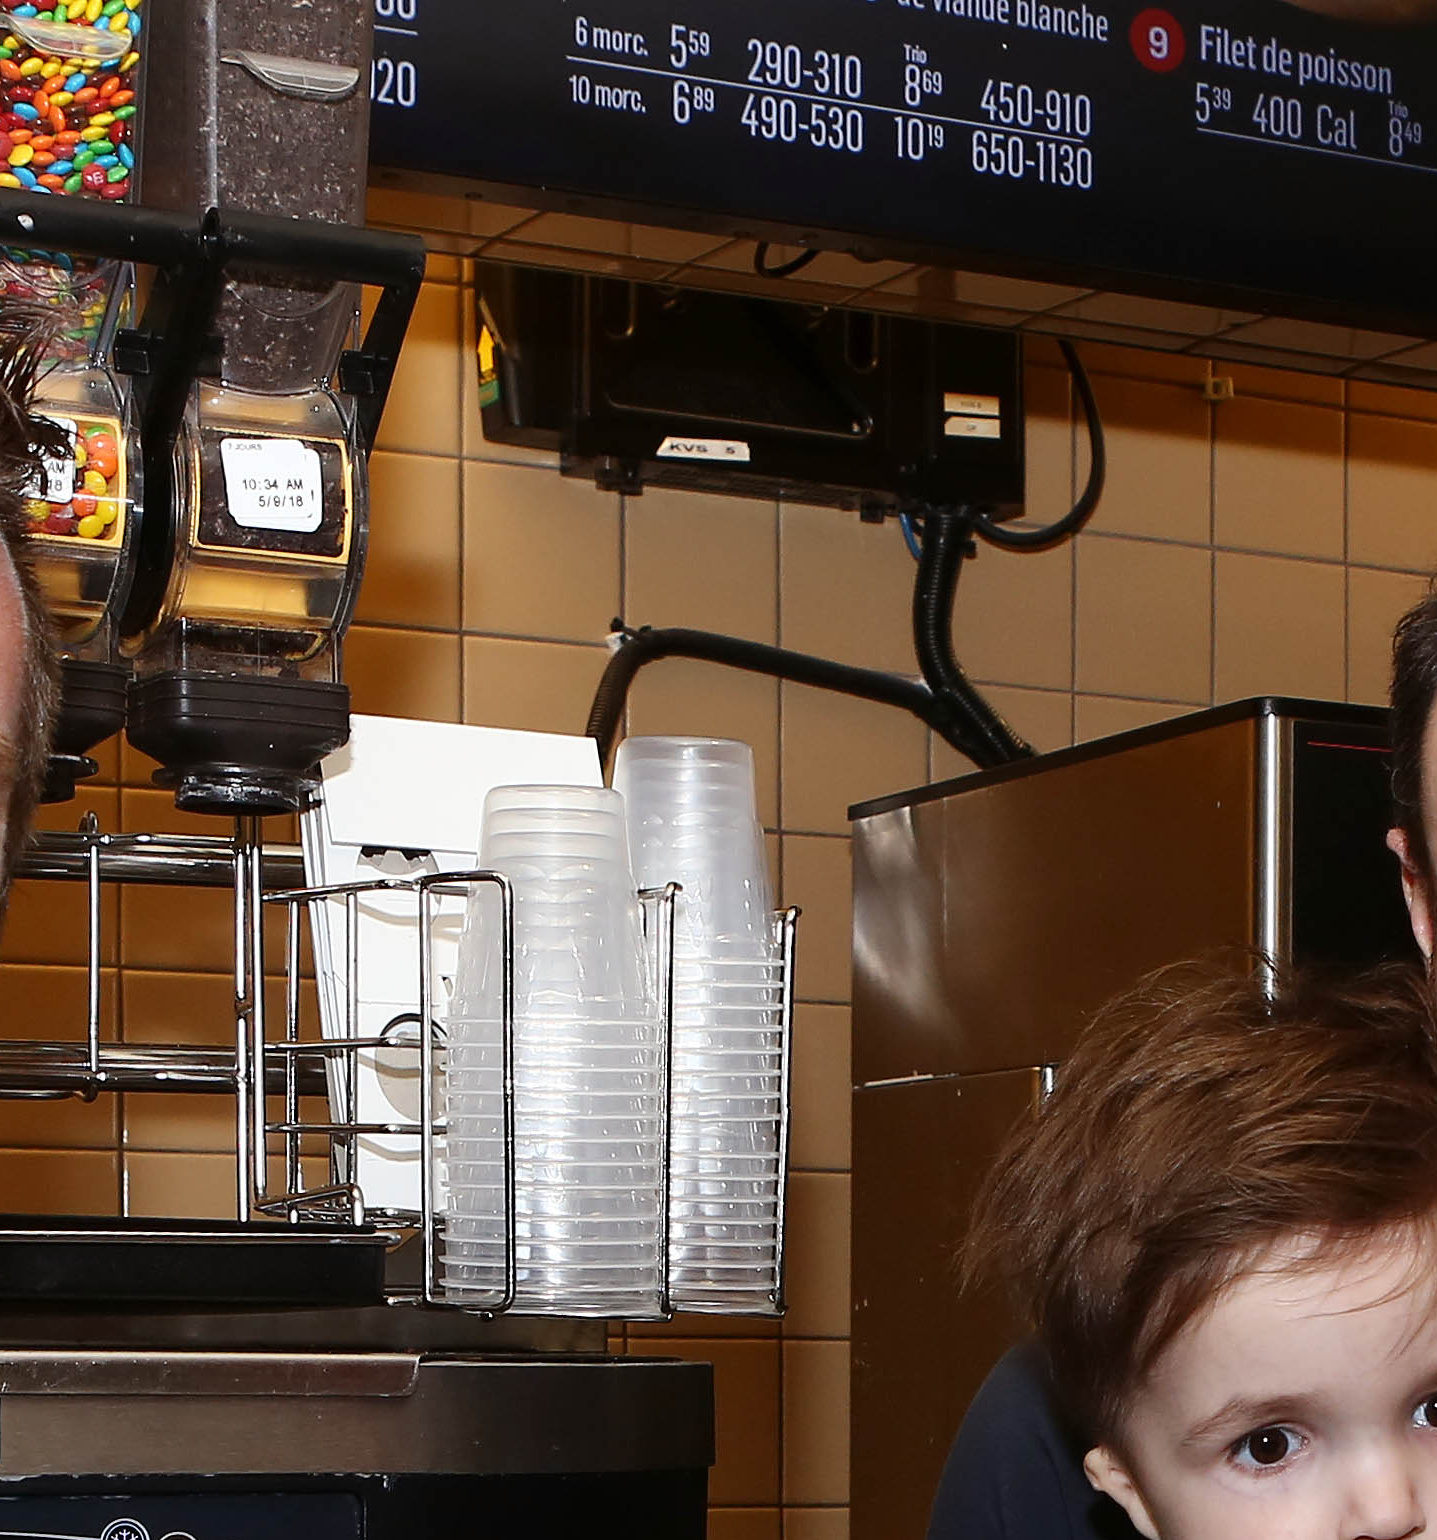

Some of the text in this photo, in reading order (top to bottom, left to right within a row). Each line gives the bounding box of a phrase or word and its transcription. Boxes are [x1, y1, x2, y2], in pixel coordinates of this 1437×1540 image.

[1017, 0, 1108, 41] blanche
[575, 16, 588, 46] 6
[592, 27, 648, 56] morc.
[747, 38, 862, 98] 290-310
[903, 44, 927, 63] Trio
[1149, 24, 1392, 94] 9 Filet de poisson
[980, 79, 1091, 136] 450-910
[1253, 93, 1302, 139] 400
[1317, 105, 1357, 149] Cal
[569, 75, 590, 104] 10
[595, 84, 646, 113] morc.
[741, 93, 862, 152] 490-530
[971, 130, 1092, 189] 650-1130
[670, 443, 708, 453] KVS
[243, 479, 303, 490] 10:34 AM
[258, 495, 303, 507] 5/9/18
